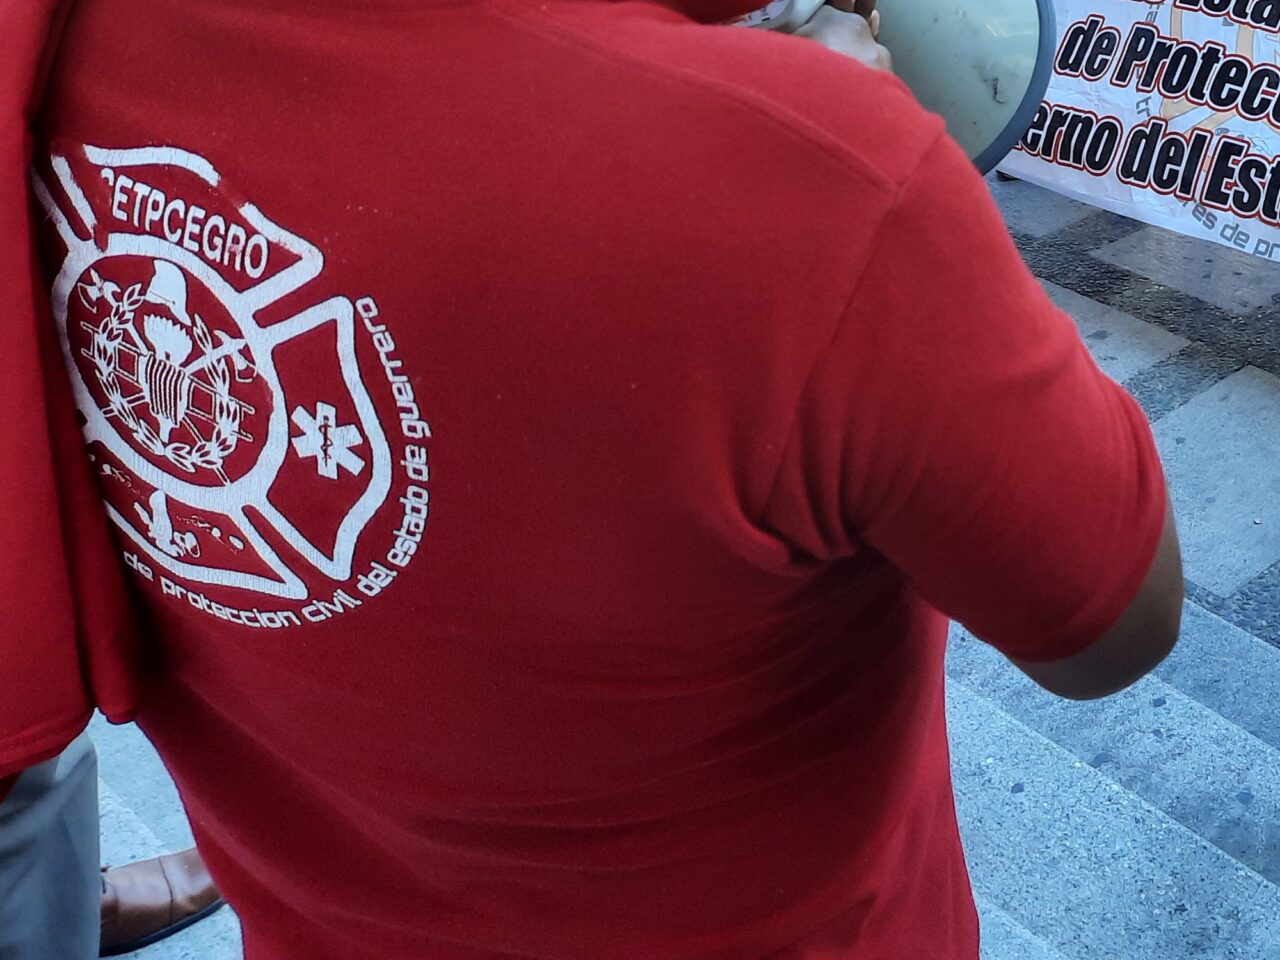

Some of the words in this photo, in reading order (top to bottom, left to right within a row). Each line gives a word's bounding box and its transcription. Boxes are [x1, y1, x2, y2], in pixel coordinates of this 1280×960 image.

[1054, 14, 1121, 86] de
[1116, 117, 1213, 201] del
[1219, 223, 1250, 249] de
[355, 296, 432, 439] guerrero
[400, 444, 429, 482] de
[386, 485, 429, 567] estado
[123, 550, 153, 582] de
[356, 561, 398, 597] del
[301, 588, 363, 622] civil
